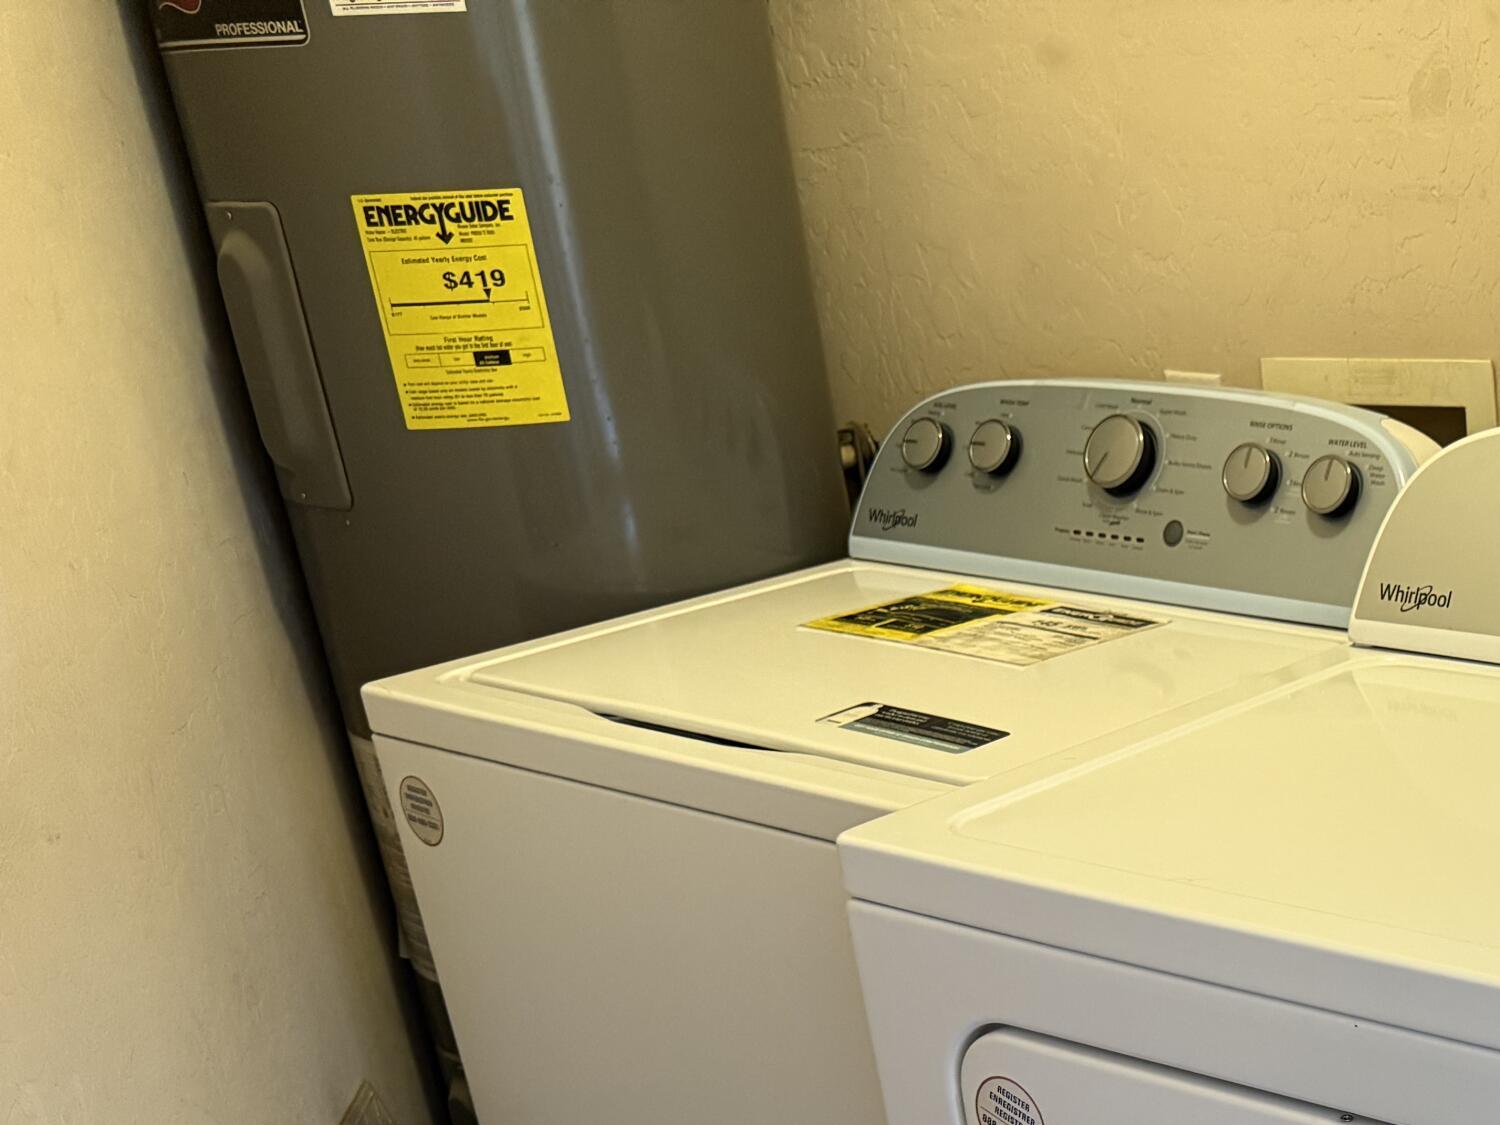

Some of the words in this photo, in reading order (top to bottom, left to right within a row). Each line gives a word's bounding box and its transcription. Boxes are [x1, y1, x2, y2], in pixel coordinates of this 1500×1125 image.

[215, 20, 303, 36] PROFESSIONAL
[363, 200, 514, 232] ENERGYGUIDE
[442, 269, 506, 292] $419
[1267, 423, 1292, 431] OPTIONS
[1328, 439, 1350, 447] WATER
[869, 508, 918, 531] Whirlpool
[1380, 583, 1452, 612] Whirlpool
[997, 1085, 1030, 1113] REGISTER
